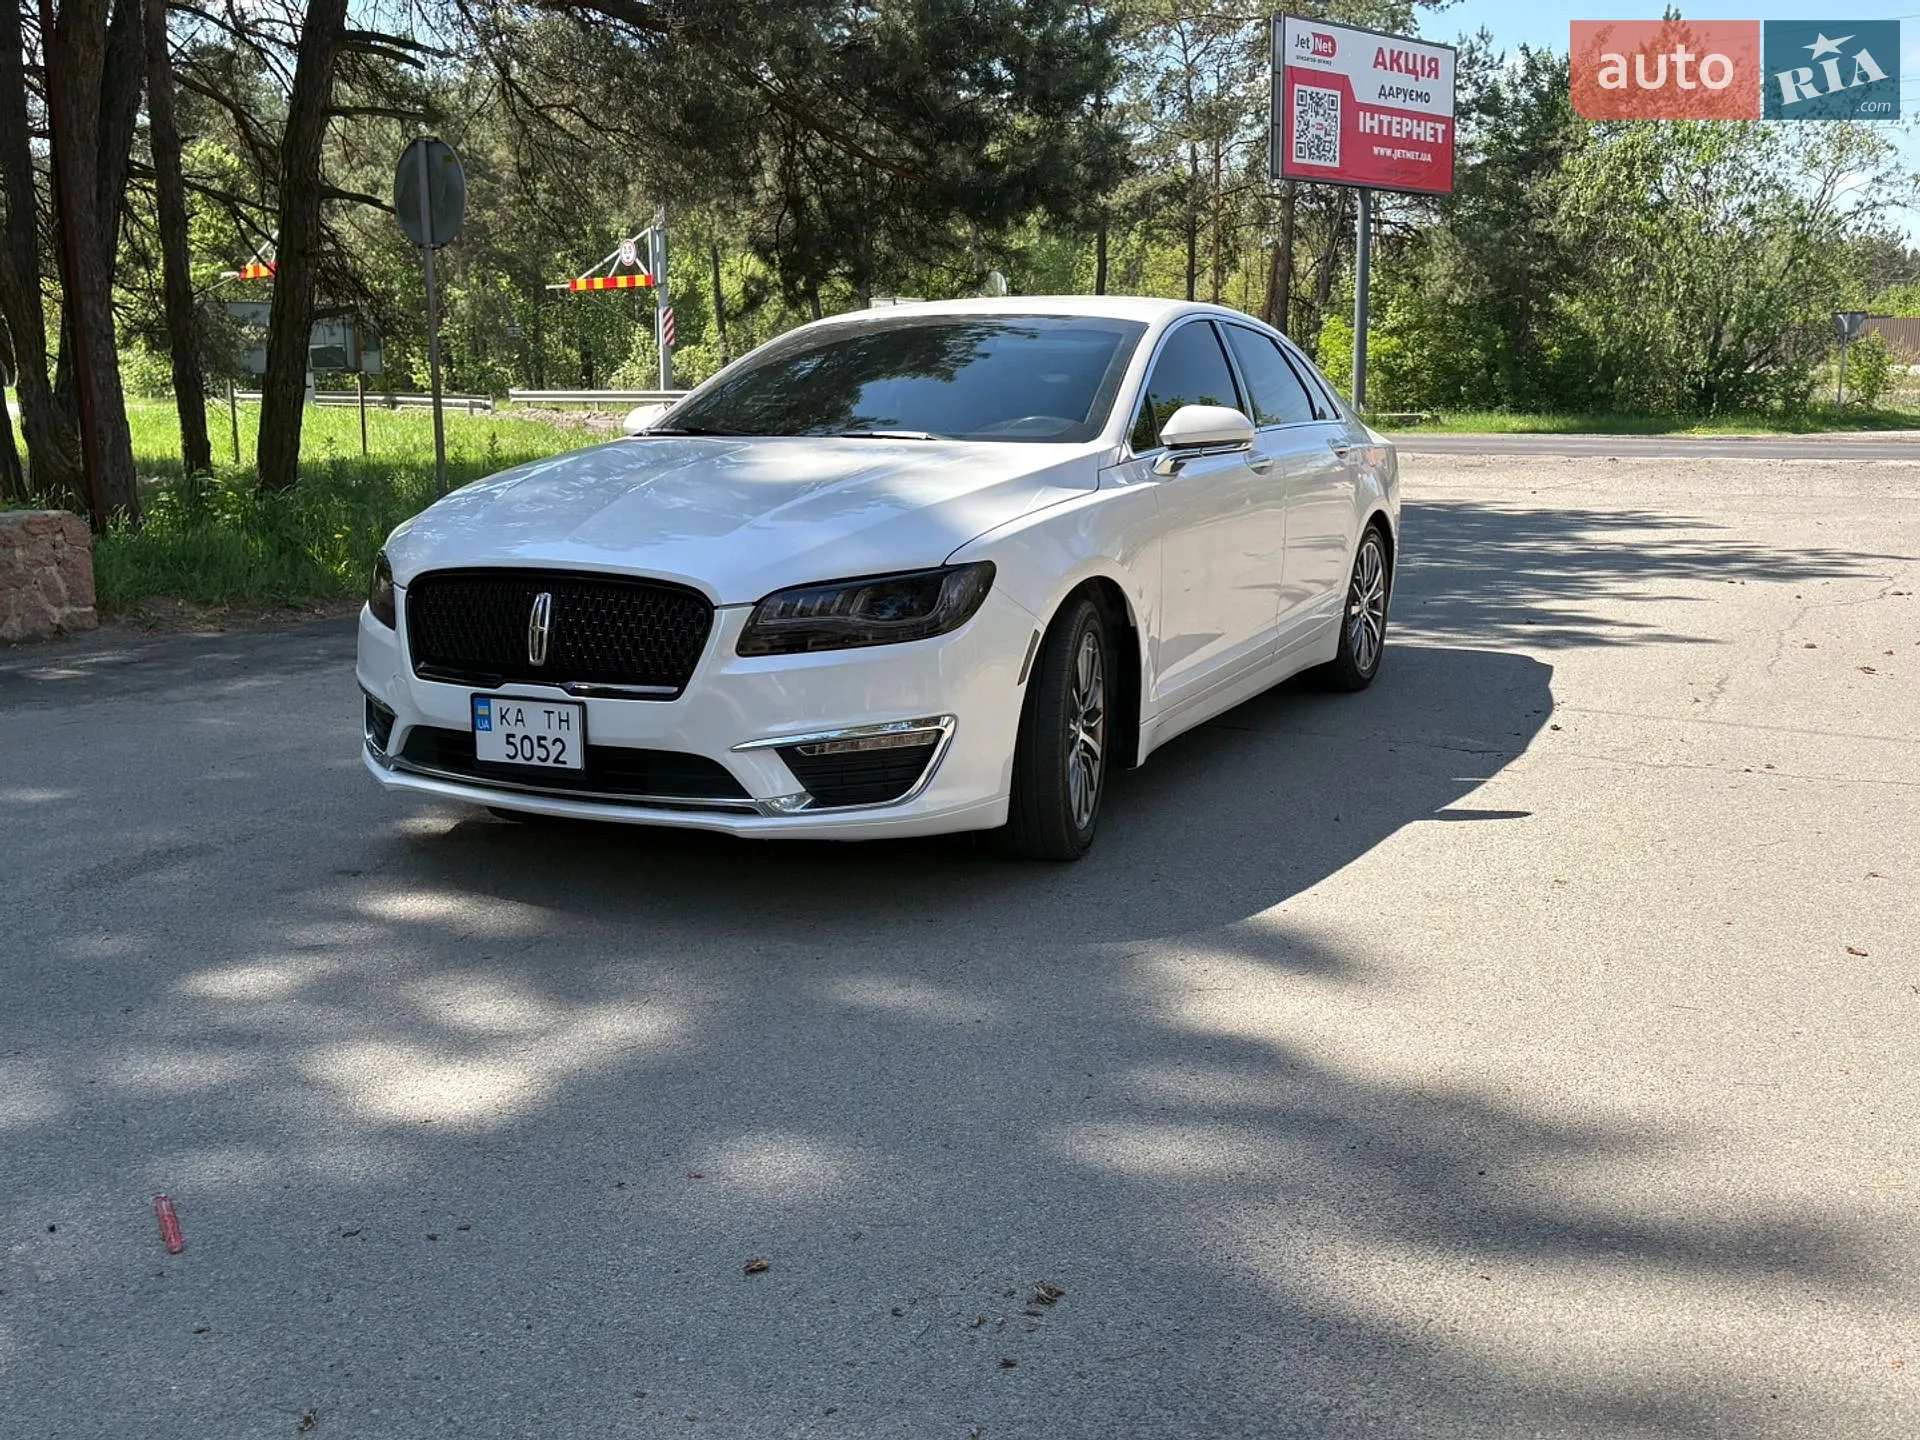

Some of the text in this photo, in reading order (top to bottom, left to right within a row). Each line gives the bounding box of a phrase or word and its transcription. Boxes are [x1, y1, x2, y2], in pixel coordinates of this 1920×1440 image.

[1295, 33, 1332, 54] Jet Net
[1372, 46, 1440, 82] АКЦІЯ
[1378, 84, 1431, 104] ДАРУЄМО
[1358, 110, 1446, 144] ІНТЕРНЕТ
[477, 718, 490, 730] UA
[499, 706, 570, 731] KA TH
[505, 733, 568, 765] 5052
